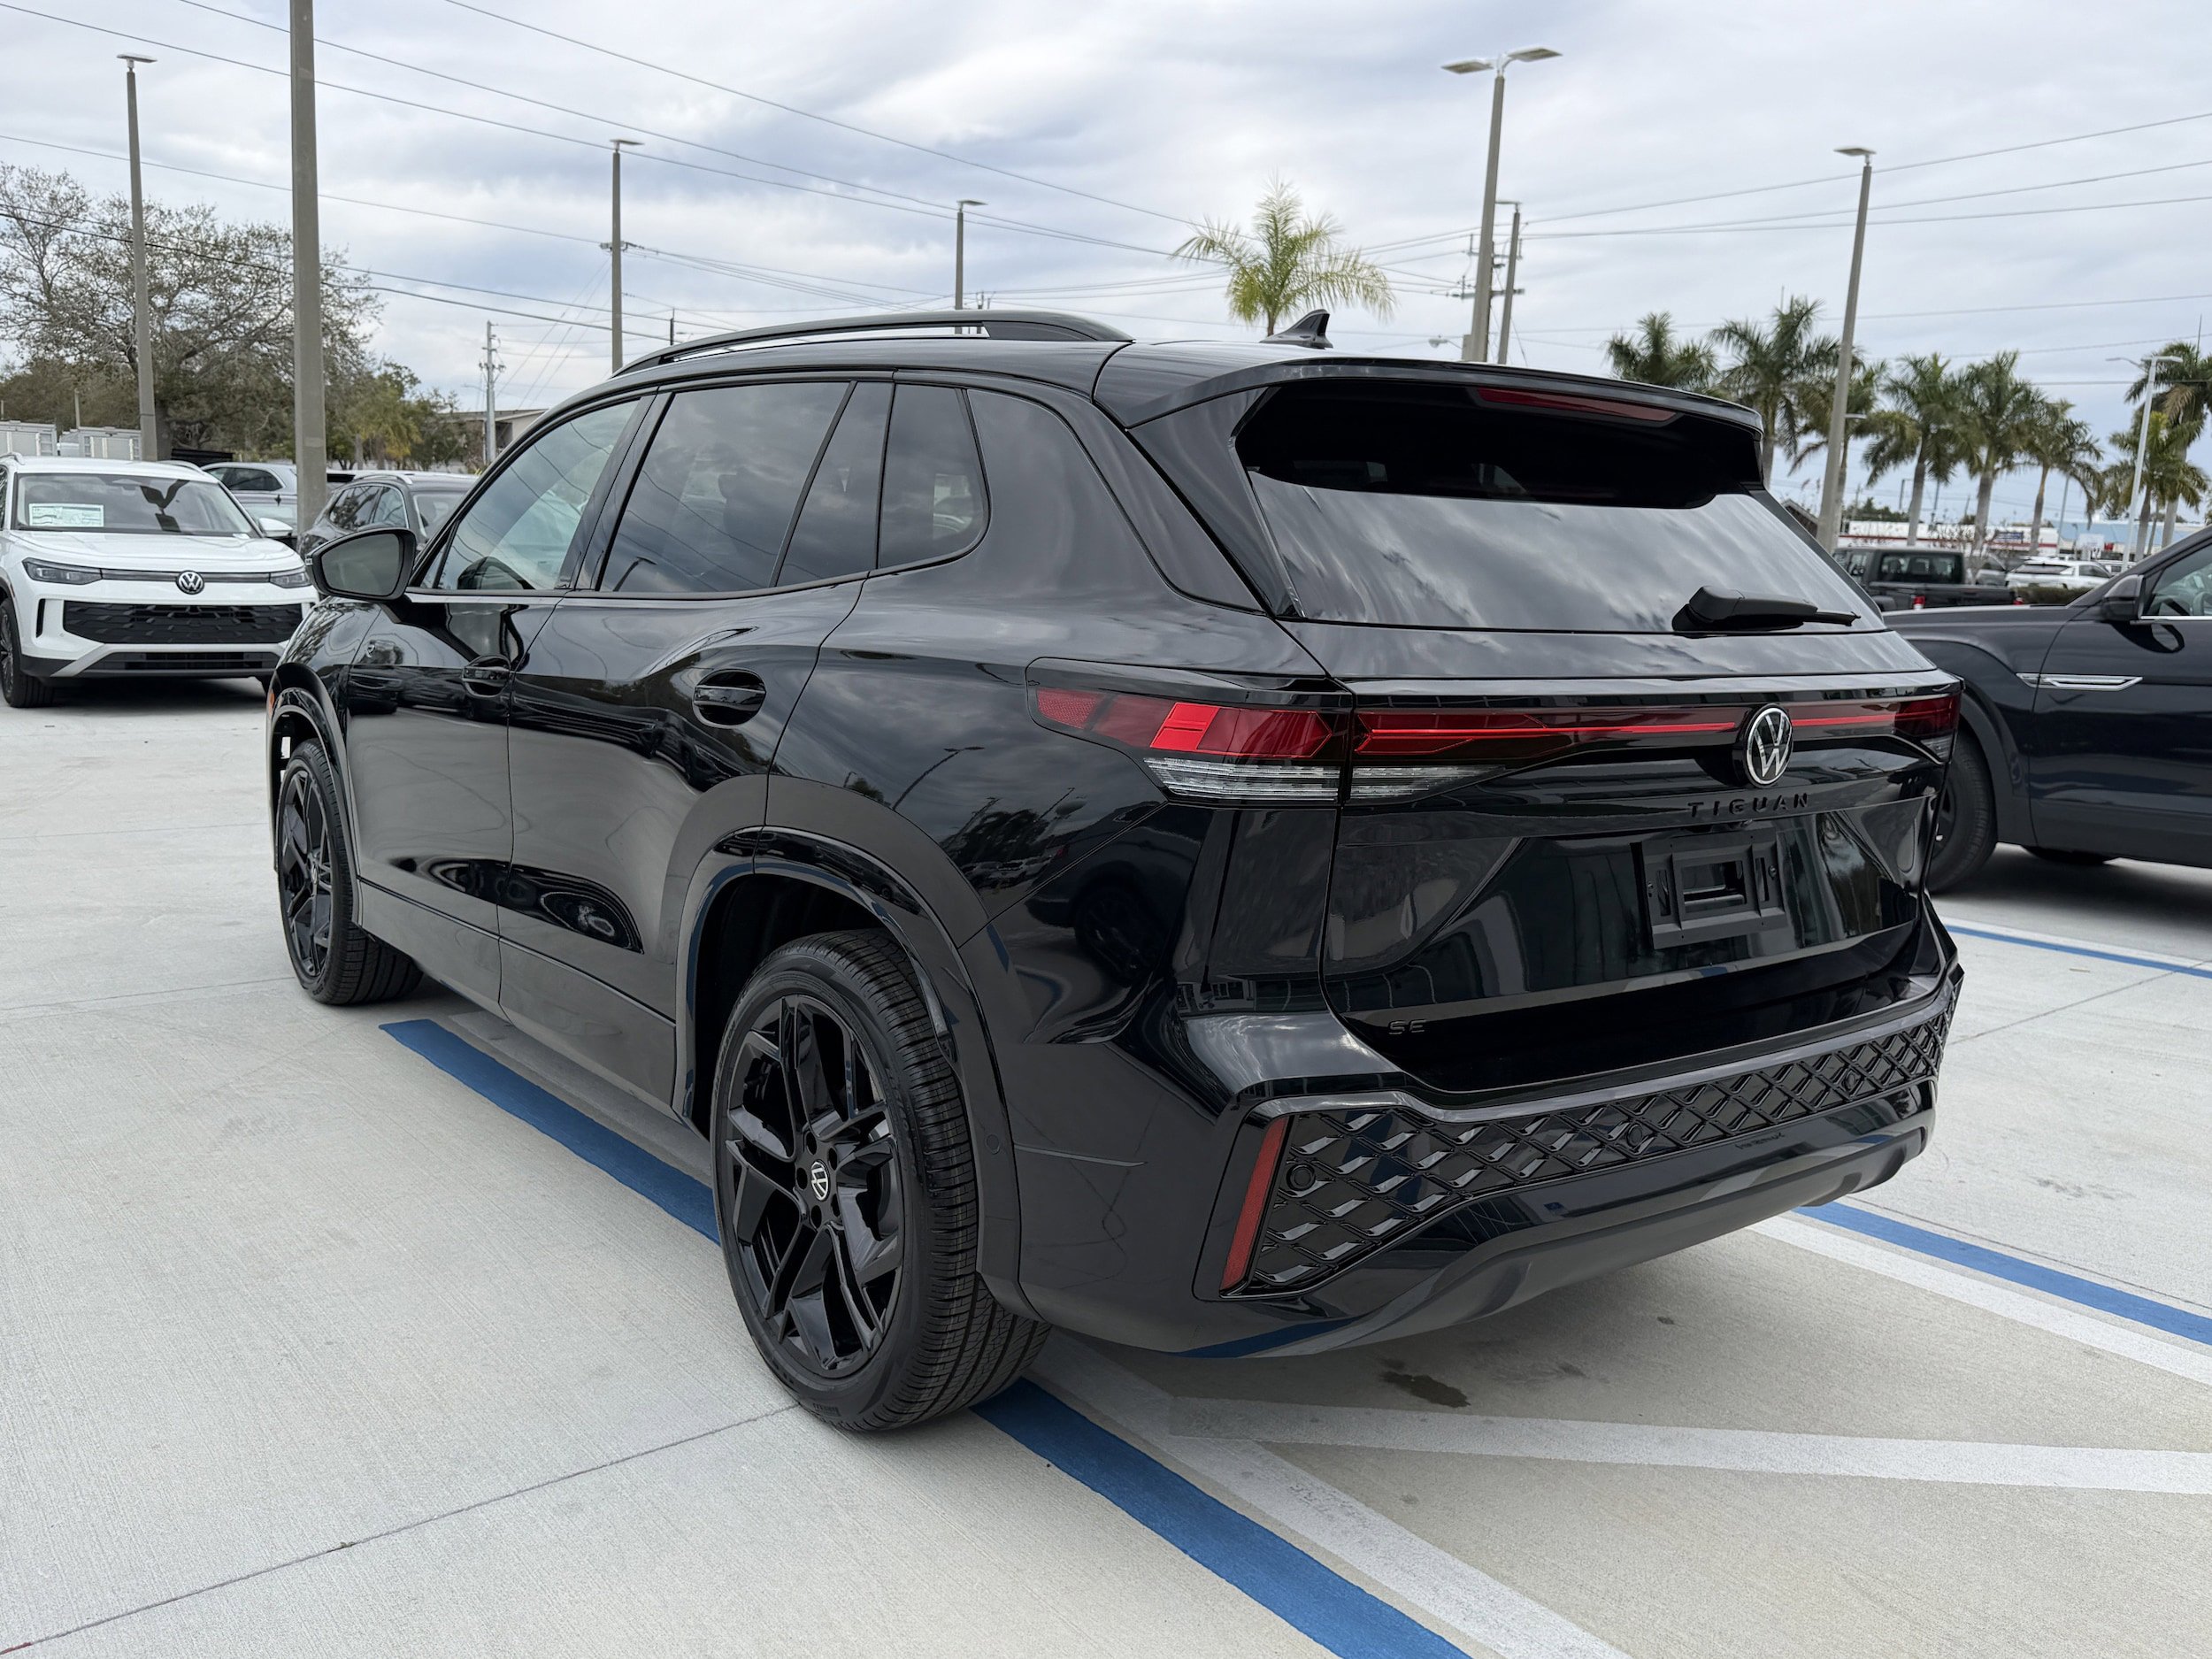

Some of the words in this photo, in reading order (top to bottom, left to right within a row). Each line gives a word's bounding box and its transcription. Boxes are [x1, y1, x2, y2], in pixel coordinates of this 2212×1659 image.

[1747, 708, 1792, 783] VW
[1687, 792, 1809, 818] TIGUAN
[1387, 1018, 1427, 1035] SE
